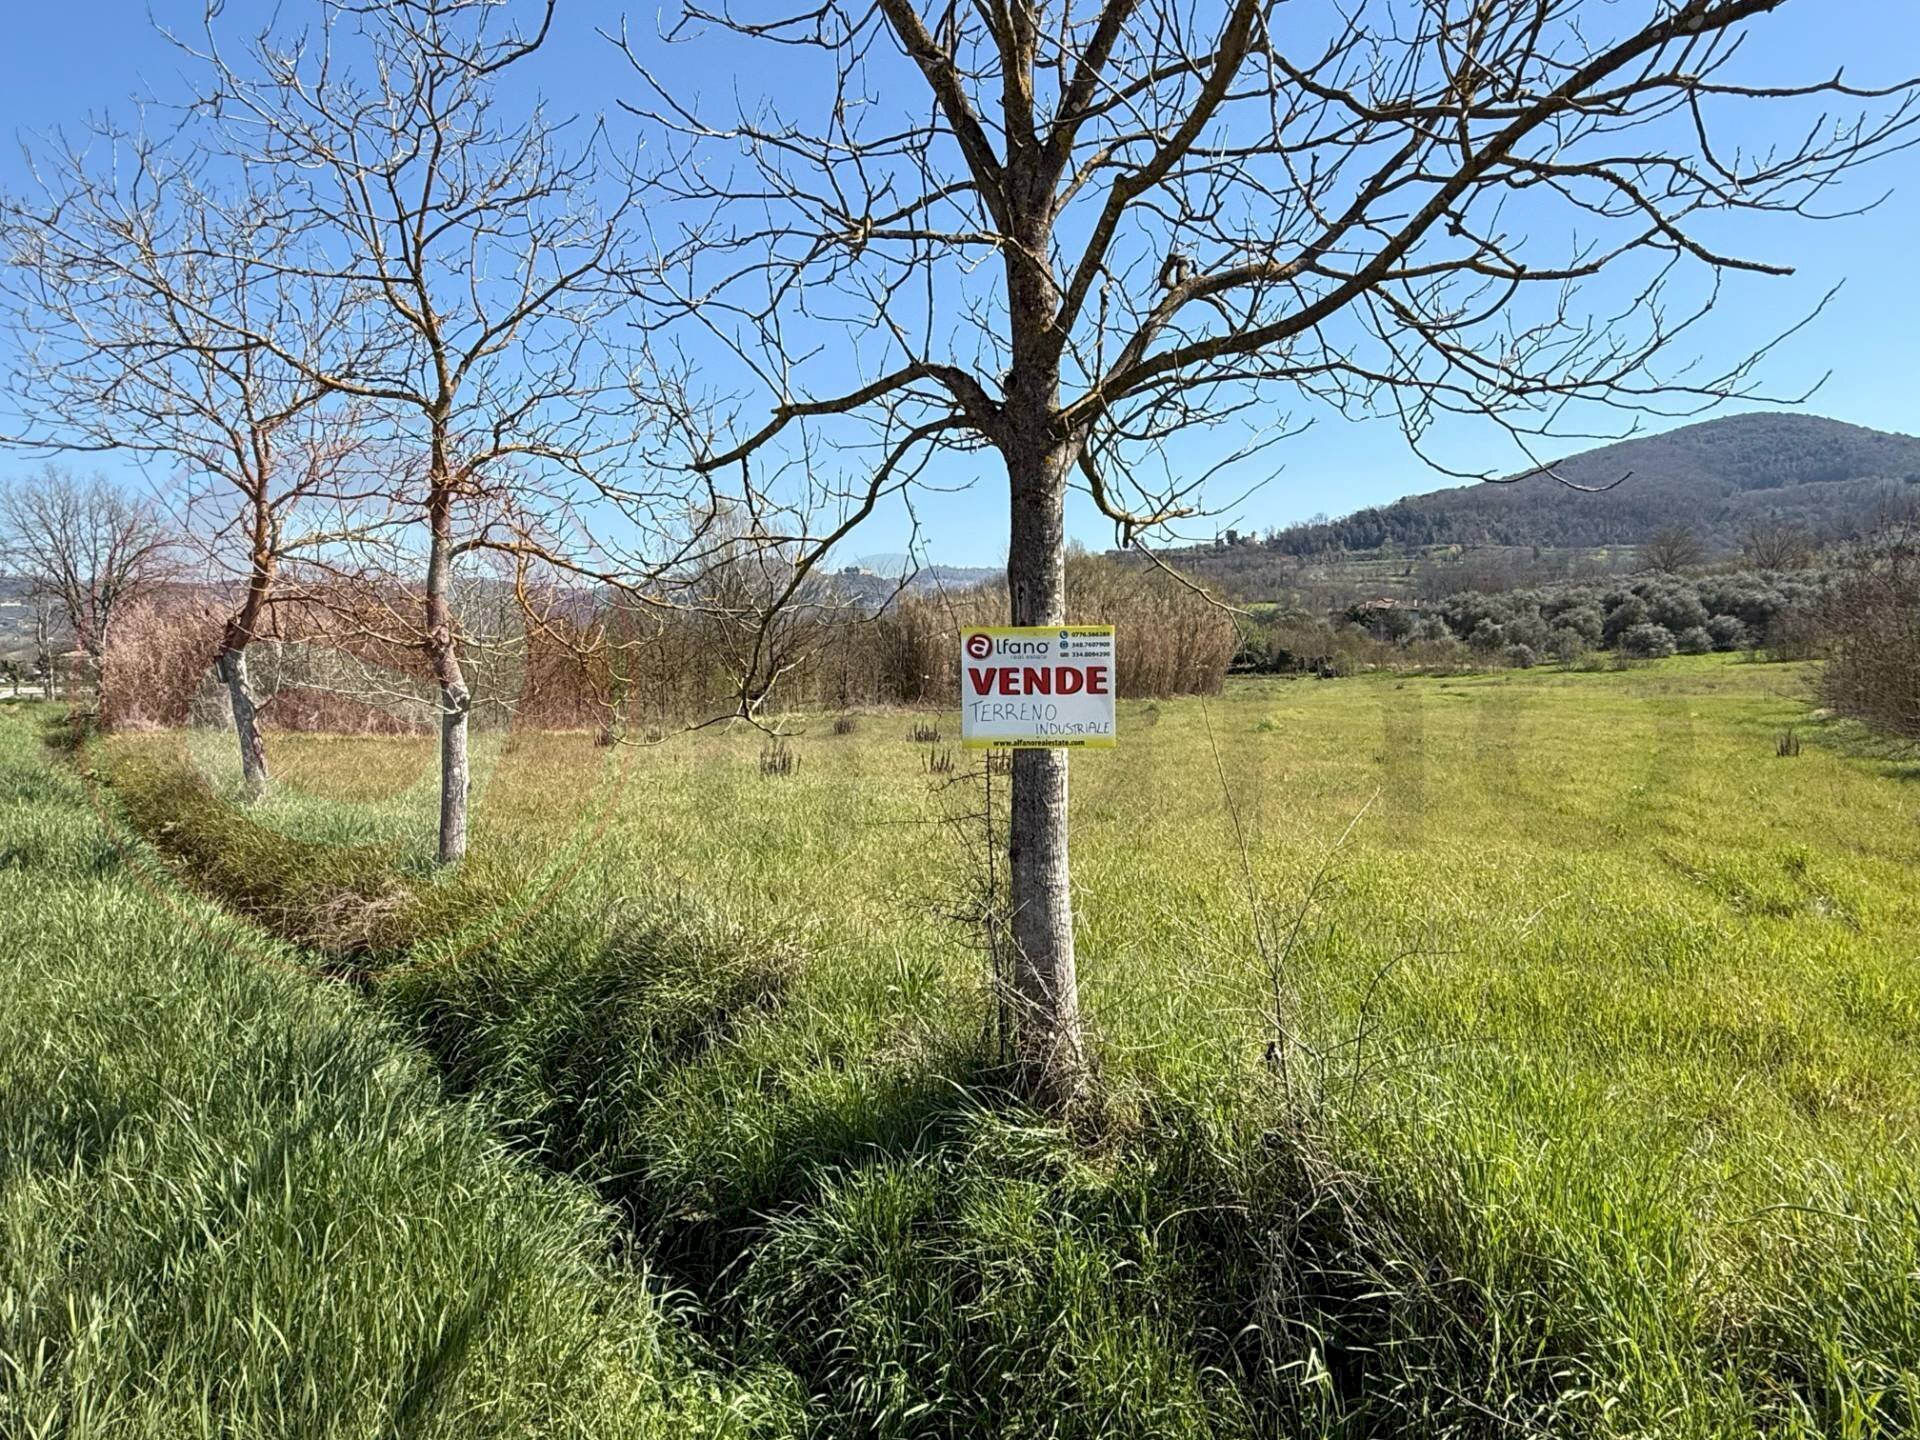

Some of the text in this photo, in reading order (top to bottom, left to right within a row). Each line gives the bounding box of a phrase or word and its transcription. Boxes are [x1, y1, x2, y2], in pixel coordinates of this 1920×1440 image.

[968, 666, 1109, 696] VENDE
[968, 700, 1057, 723] TERRENO
[1035, 721, 1111, 736] INDUSTRIALE
[993, 738, 1086, 747] www.alfanorealestate.com
